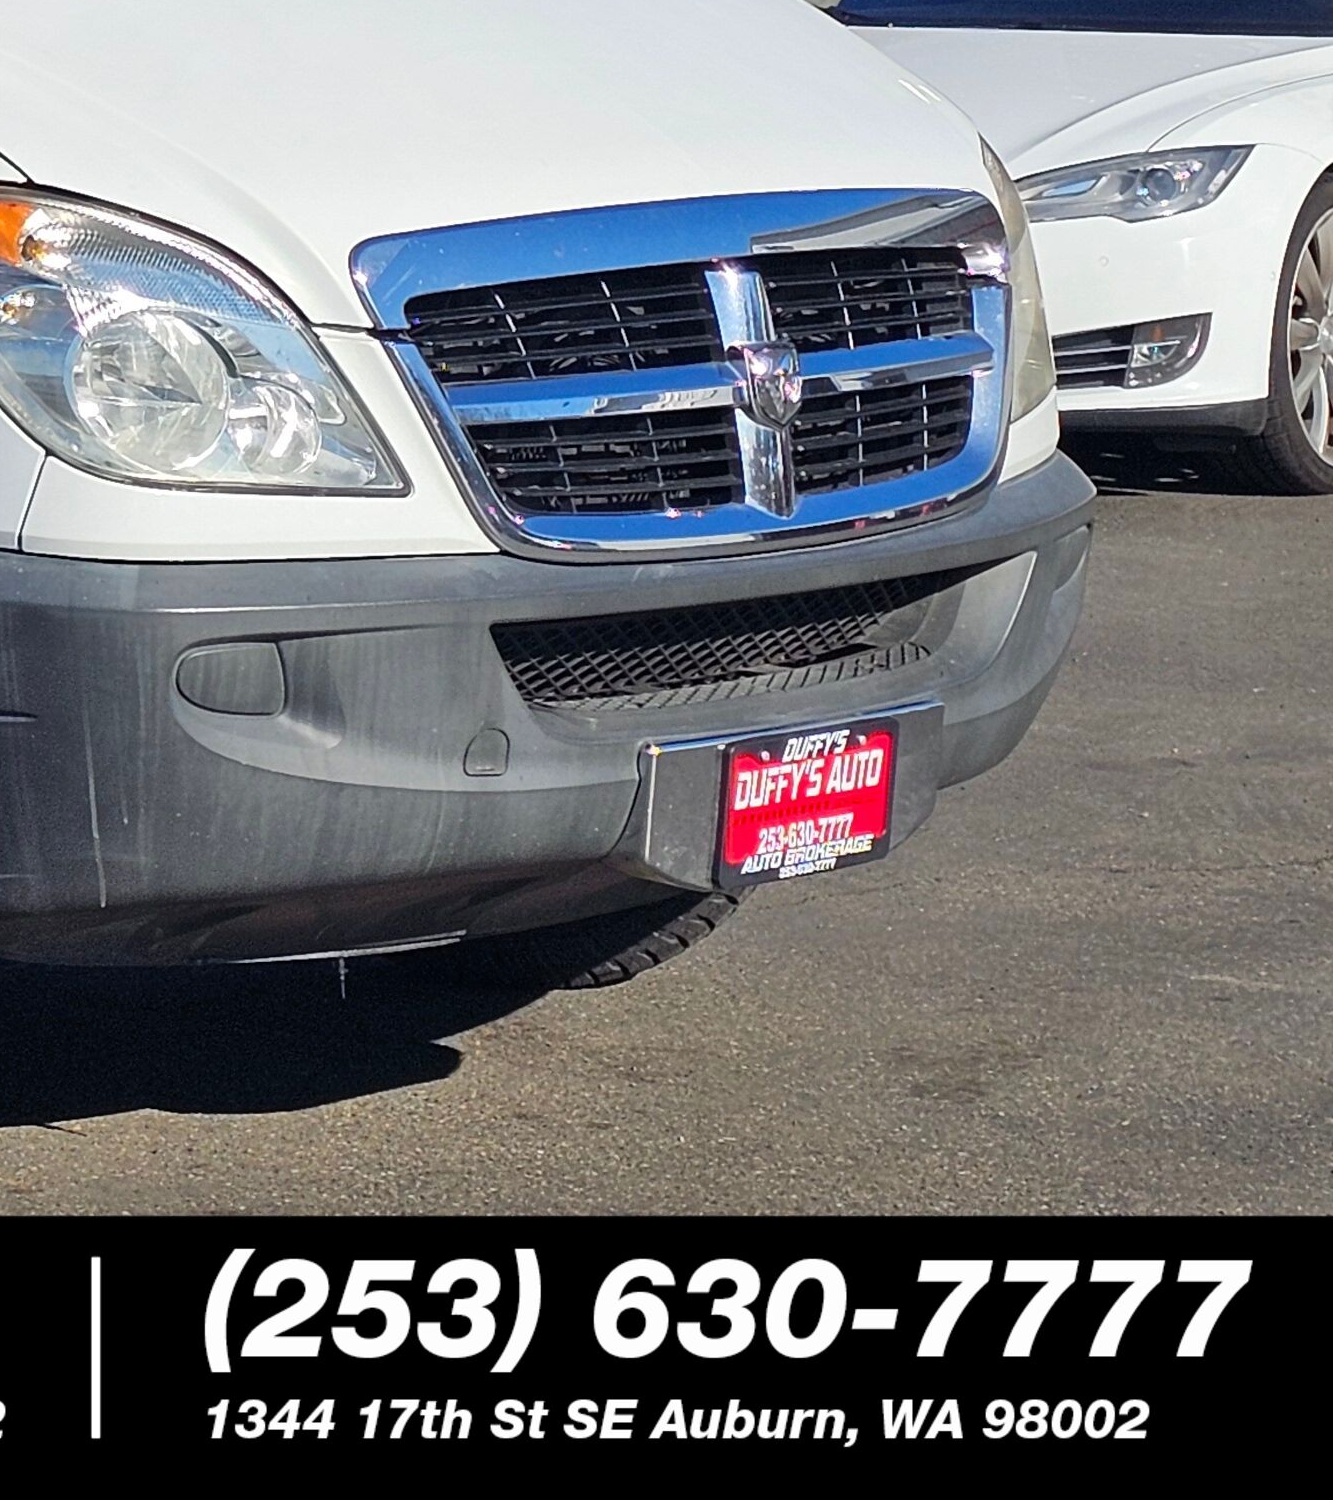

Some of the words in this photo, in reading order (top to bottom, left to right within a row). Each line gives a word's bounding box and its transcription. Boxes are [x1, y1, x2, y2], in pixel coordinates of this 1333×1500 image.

[782, 729, 850, 762] DUFFY'S
[734, 758, 825, 811] DUFFY'S
[826, 749, 884, 794] AUTO
[741, 851, 782, 874] AUTO
[783, 833, 875, 866] BROKERAGE
[758, 813, 853, 854] 253-630-7777
